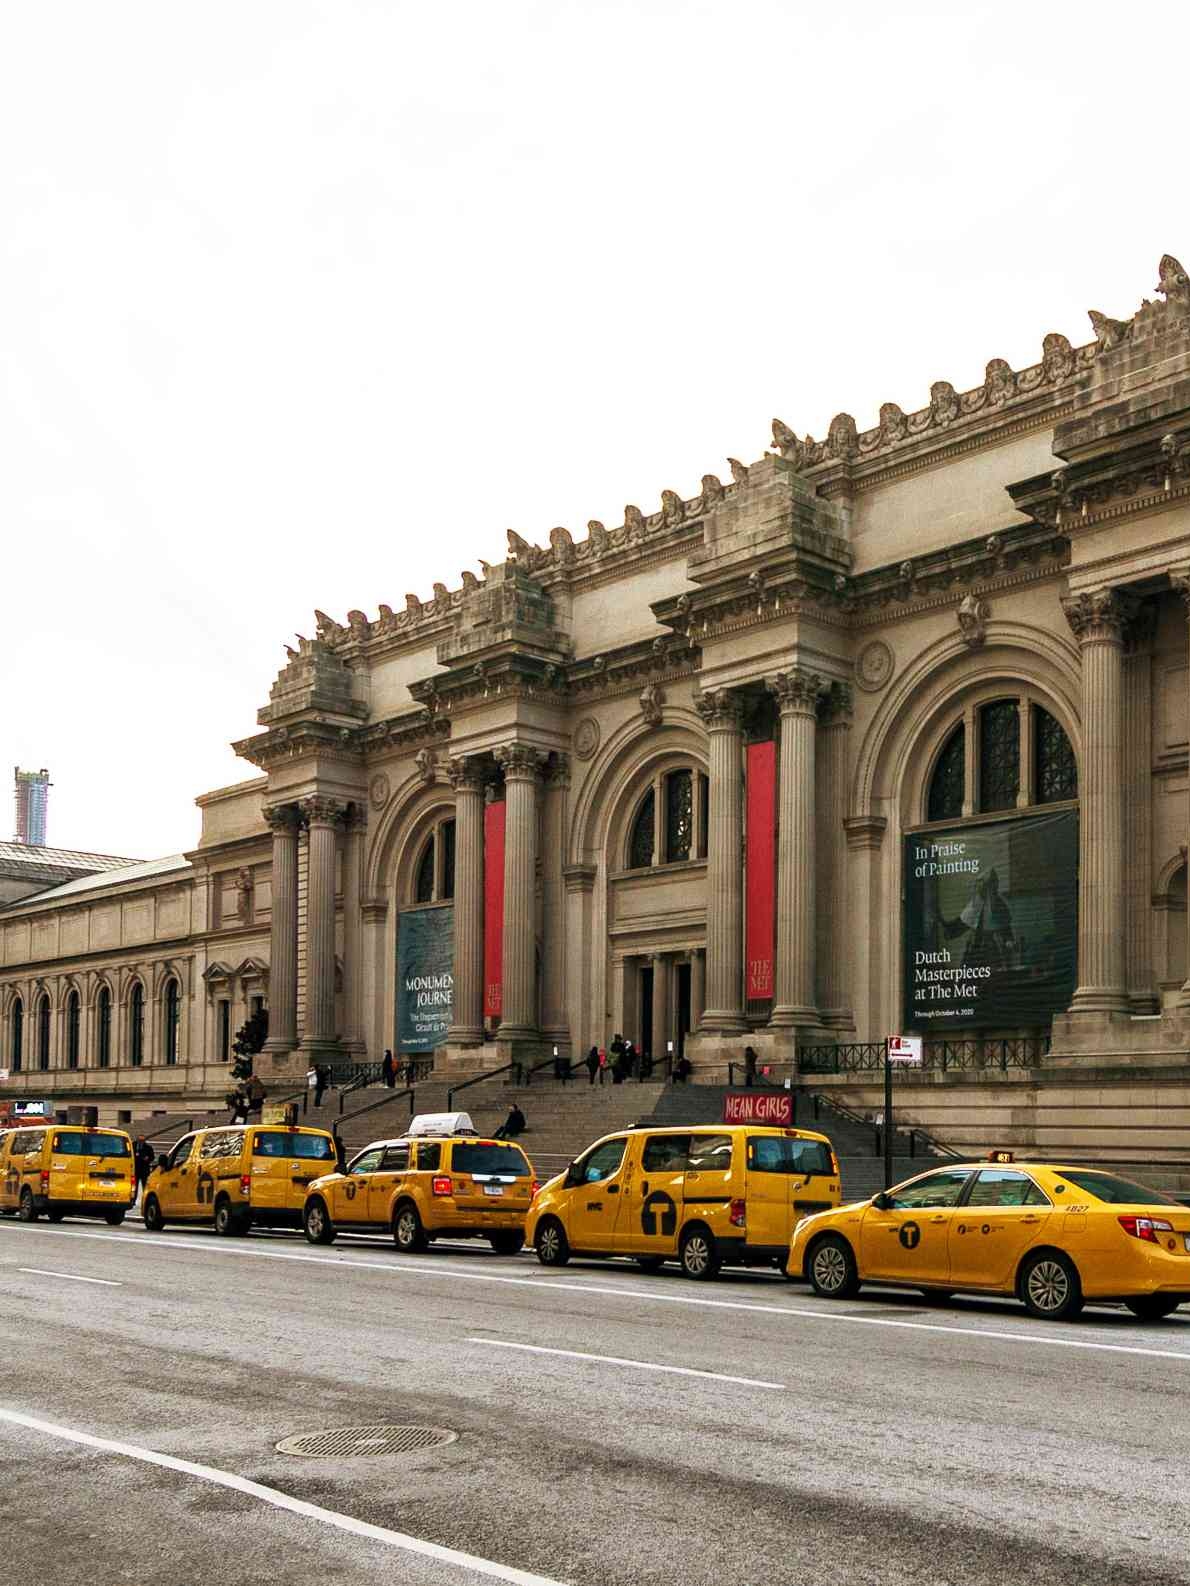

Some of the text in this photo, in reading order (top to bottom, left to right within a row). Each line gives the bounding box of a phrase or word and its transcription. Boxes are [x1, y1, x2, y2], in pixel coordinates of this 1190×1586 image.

[915, 841, 966, 860] In Praise
[915, 859, 979, 878] of Painting
[915, 948, 951, 965] Dutch
[915, 964, 991, 982] Masterpieces
[914, 984, 977, 1000] at The Met
[725, 1097, 789, 1120] MEAN GIRLS
[650, 1203, 669, 1236] T
[903, 1226, 916, 1246] T
